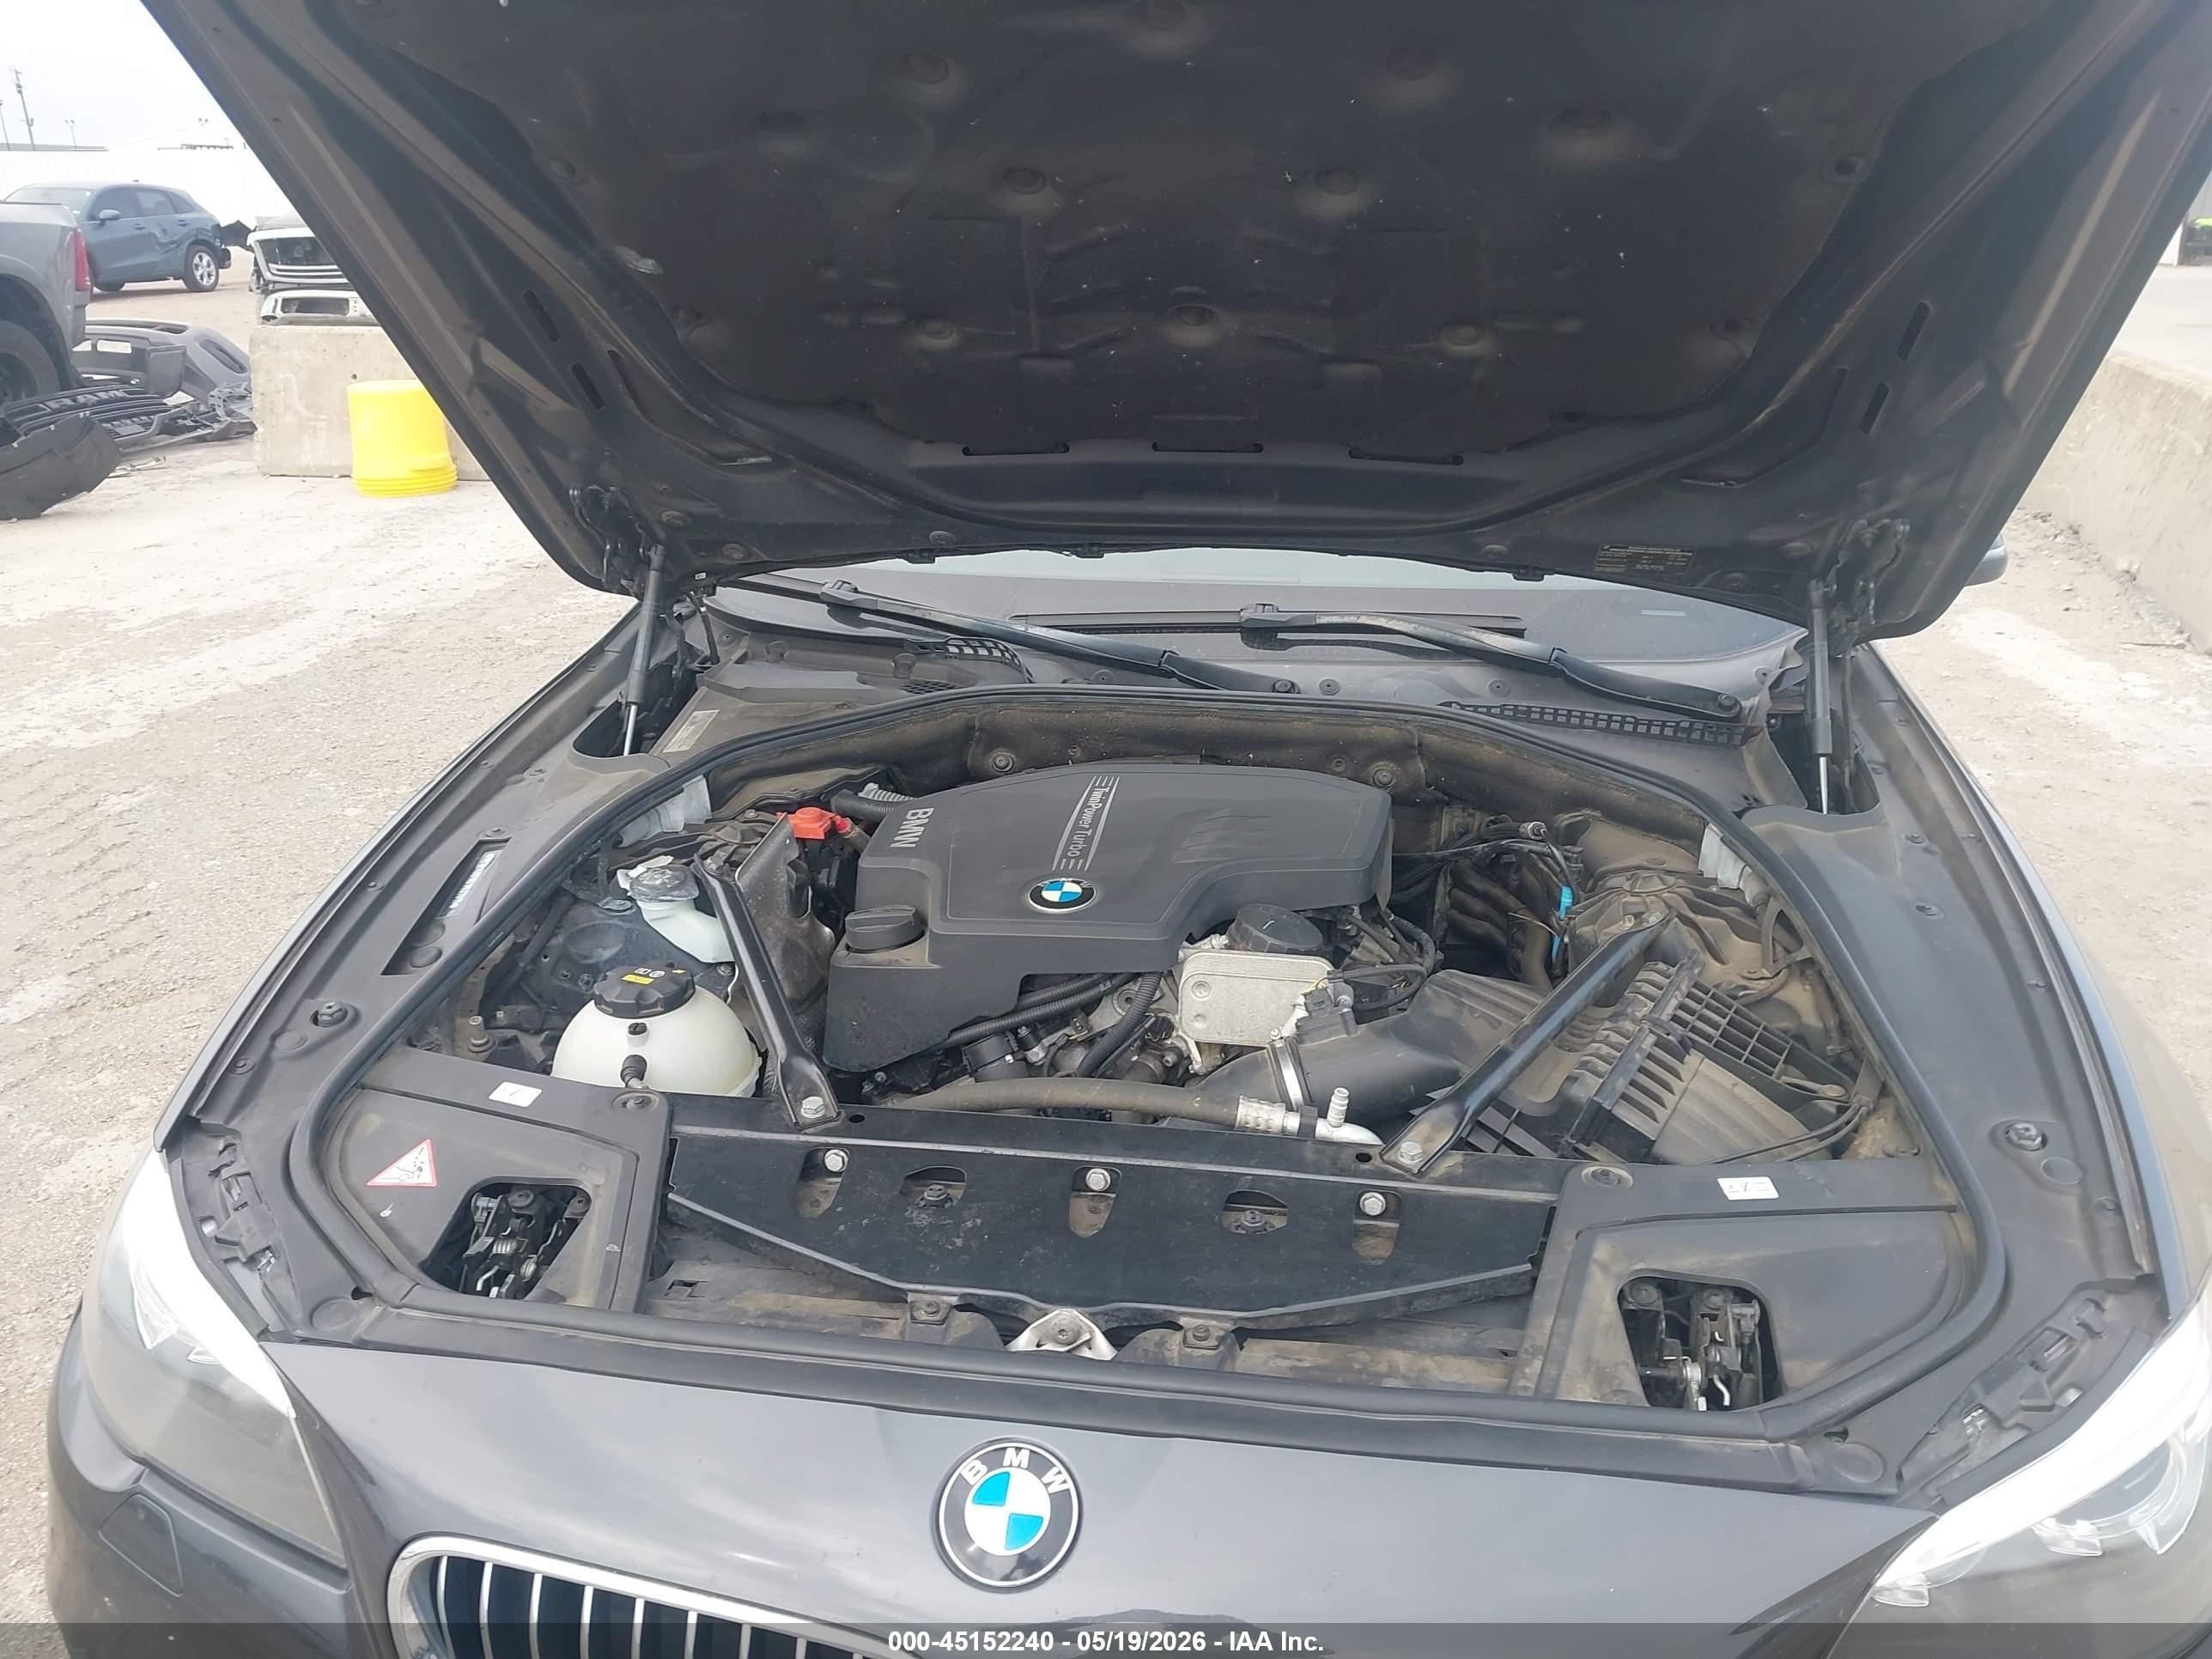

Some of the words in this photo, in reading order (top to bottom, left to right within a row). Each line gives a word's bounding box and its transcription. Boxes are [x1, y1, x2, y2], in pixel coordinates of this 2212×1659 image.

[890, 807, 935, 848] BMW
[1079, 787, 1110, 828] TwinPower
[1066, 829, 1093, 857] Turbo
[960, 1447, 1070, 1494] BMW
